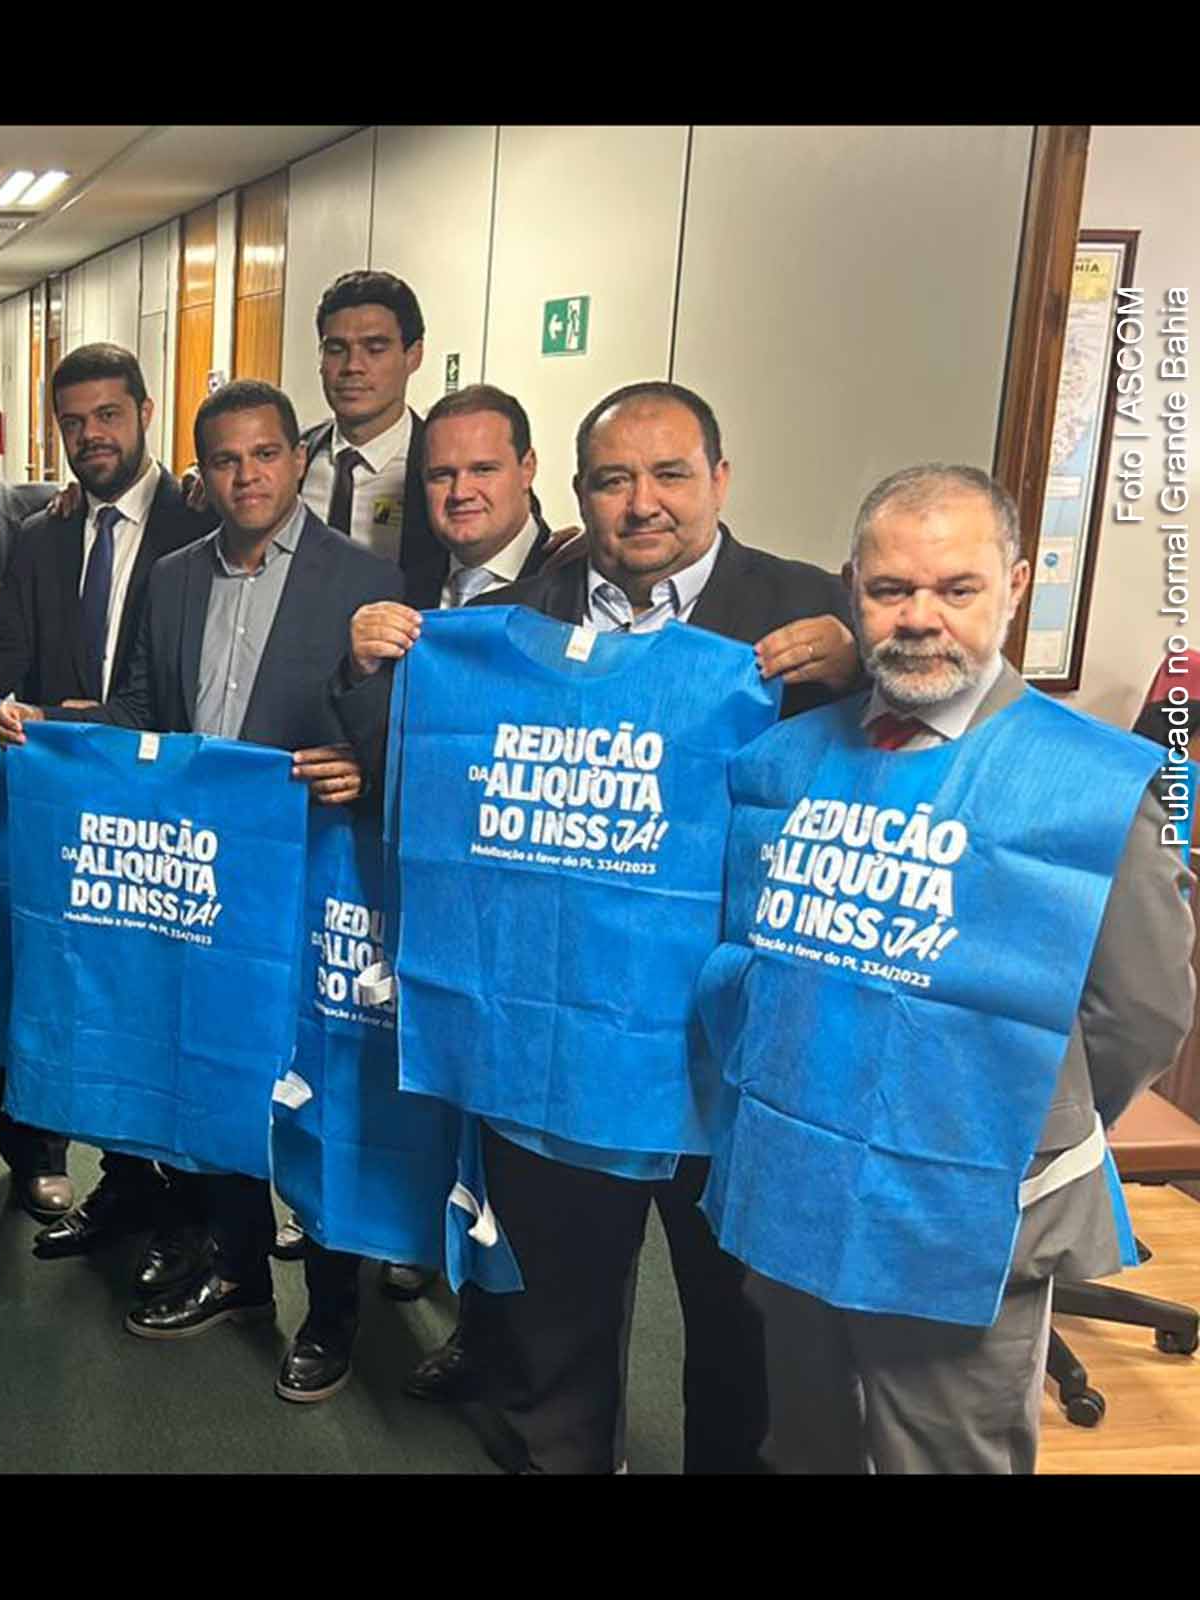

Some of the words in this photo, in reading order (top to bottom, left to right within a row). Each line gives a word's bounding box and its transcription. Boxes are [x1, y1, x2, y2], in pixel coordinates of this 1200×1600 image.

[493, 721, 664, 771] REDUÇÃO
[468, 765, 488, 782] DA
[484, 762, 663, 813] ALIQUOTA
[80, 812, 218, 862] REDUÇÃO
[479, 803, 525, 842] DO
[531, 810, 609, 852] INSS
[611, 812, 669, 854] JÁ!
[782, 797, 968, 865] REDUÇÃO
[61, 846, 78, 861] DA
[75, 844, 217, 897] ALIQUOTA
[526, 852, 534, 861] a
[536, 851, 561, 865] favor
[562, 856, 578, 867] do
[580, 857, 595, 870] PL
[597, 859, 657, 875] 334/2023
[767, 838, 954, 917] ALIQUOTA
[71, 878, 112, 910] DO
[117, 884, 179, 921] INSS
[180, 897, 223, 928] JÁ!
[325, 896, 385, 942] REDU
[756, 886, 794, 929] DO
[794, 894, 884, 950] INSS
[882, 917, 959, 961] JÁ!
[795, 946, 824, 962] favor
[824, 952, 841, 966] do
[842, 955, 859, 972] PL
[860, 959, 932, 988] 334/2023
